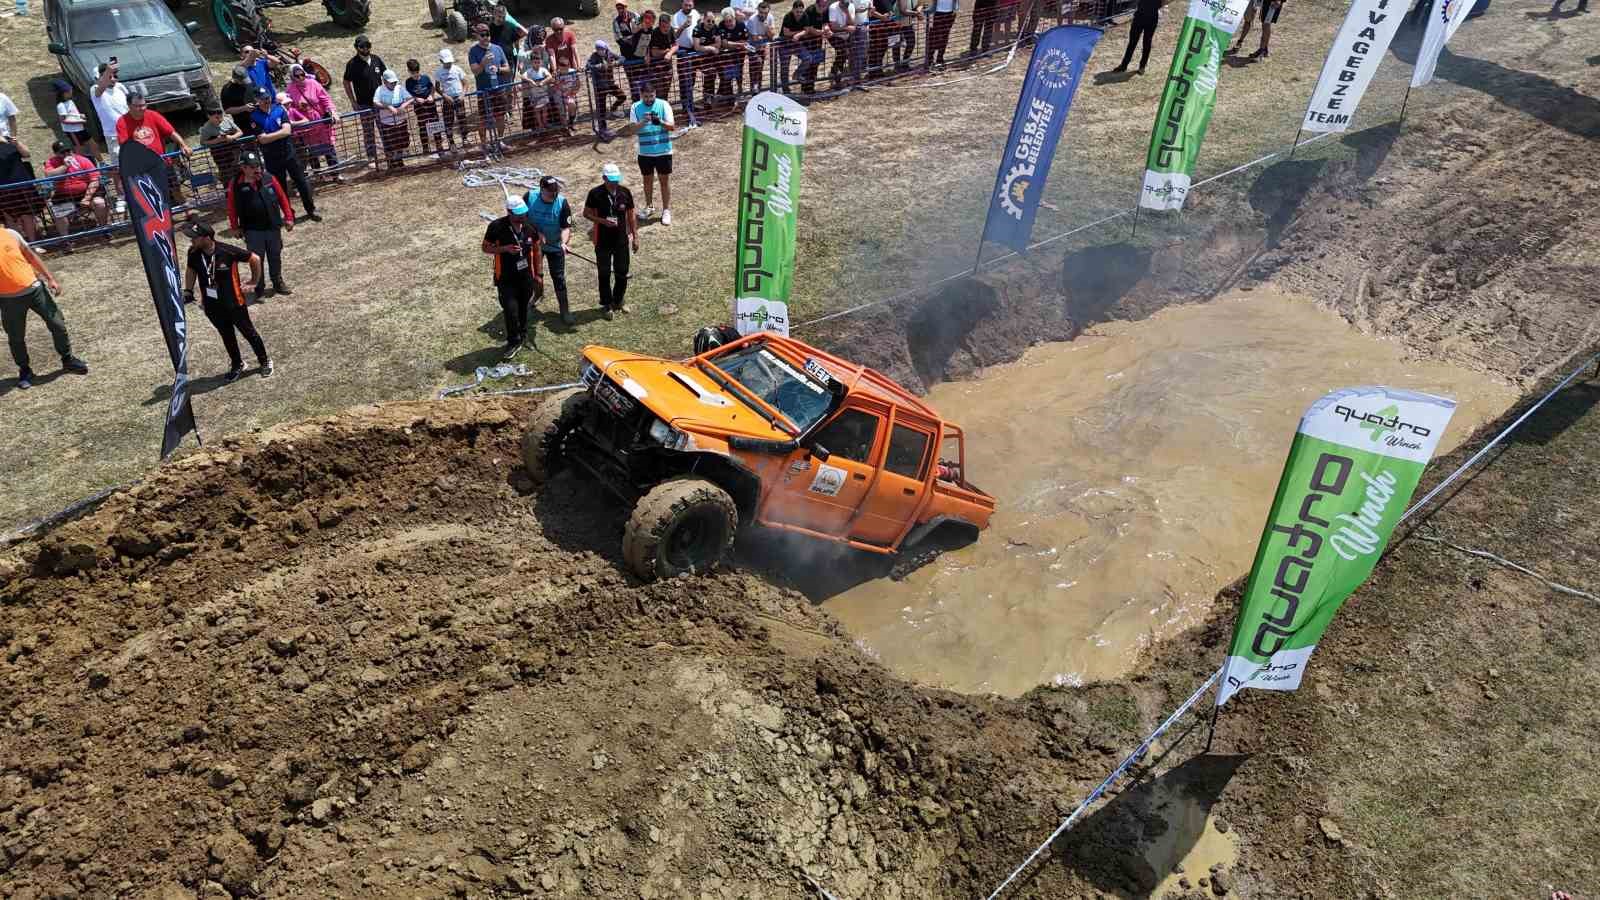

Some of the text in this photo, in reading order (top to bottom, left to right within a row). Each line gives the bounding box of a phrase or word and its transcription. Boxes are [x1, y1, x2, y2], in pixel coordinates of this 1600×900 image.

[1015, 96, 1046, 161] GEBZE
[1028, 103, 1055, 164] BELEDİYESİ
[1308, 110, 1350, 124] TEAM
[767, 152, 792, 217] Winch
[1383, 433, 1422, 450] Winch
[1328, 469, 1398, 562] Winch
